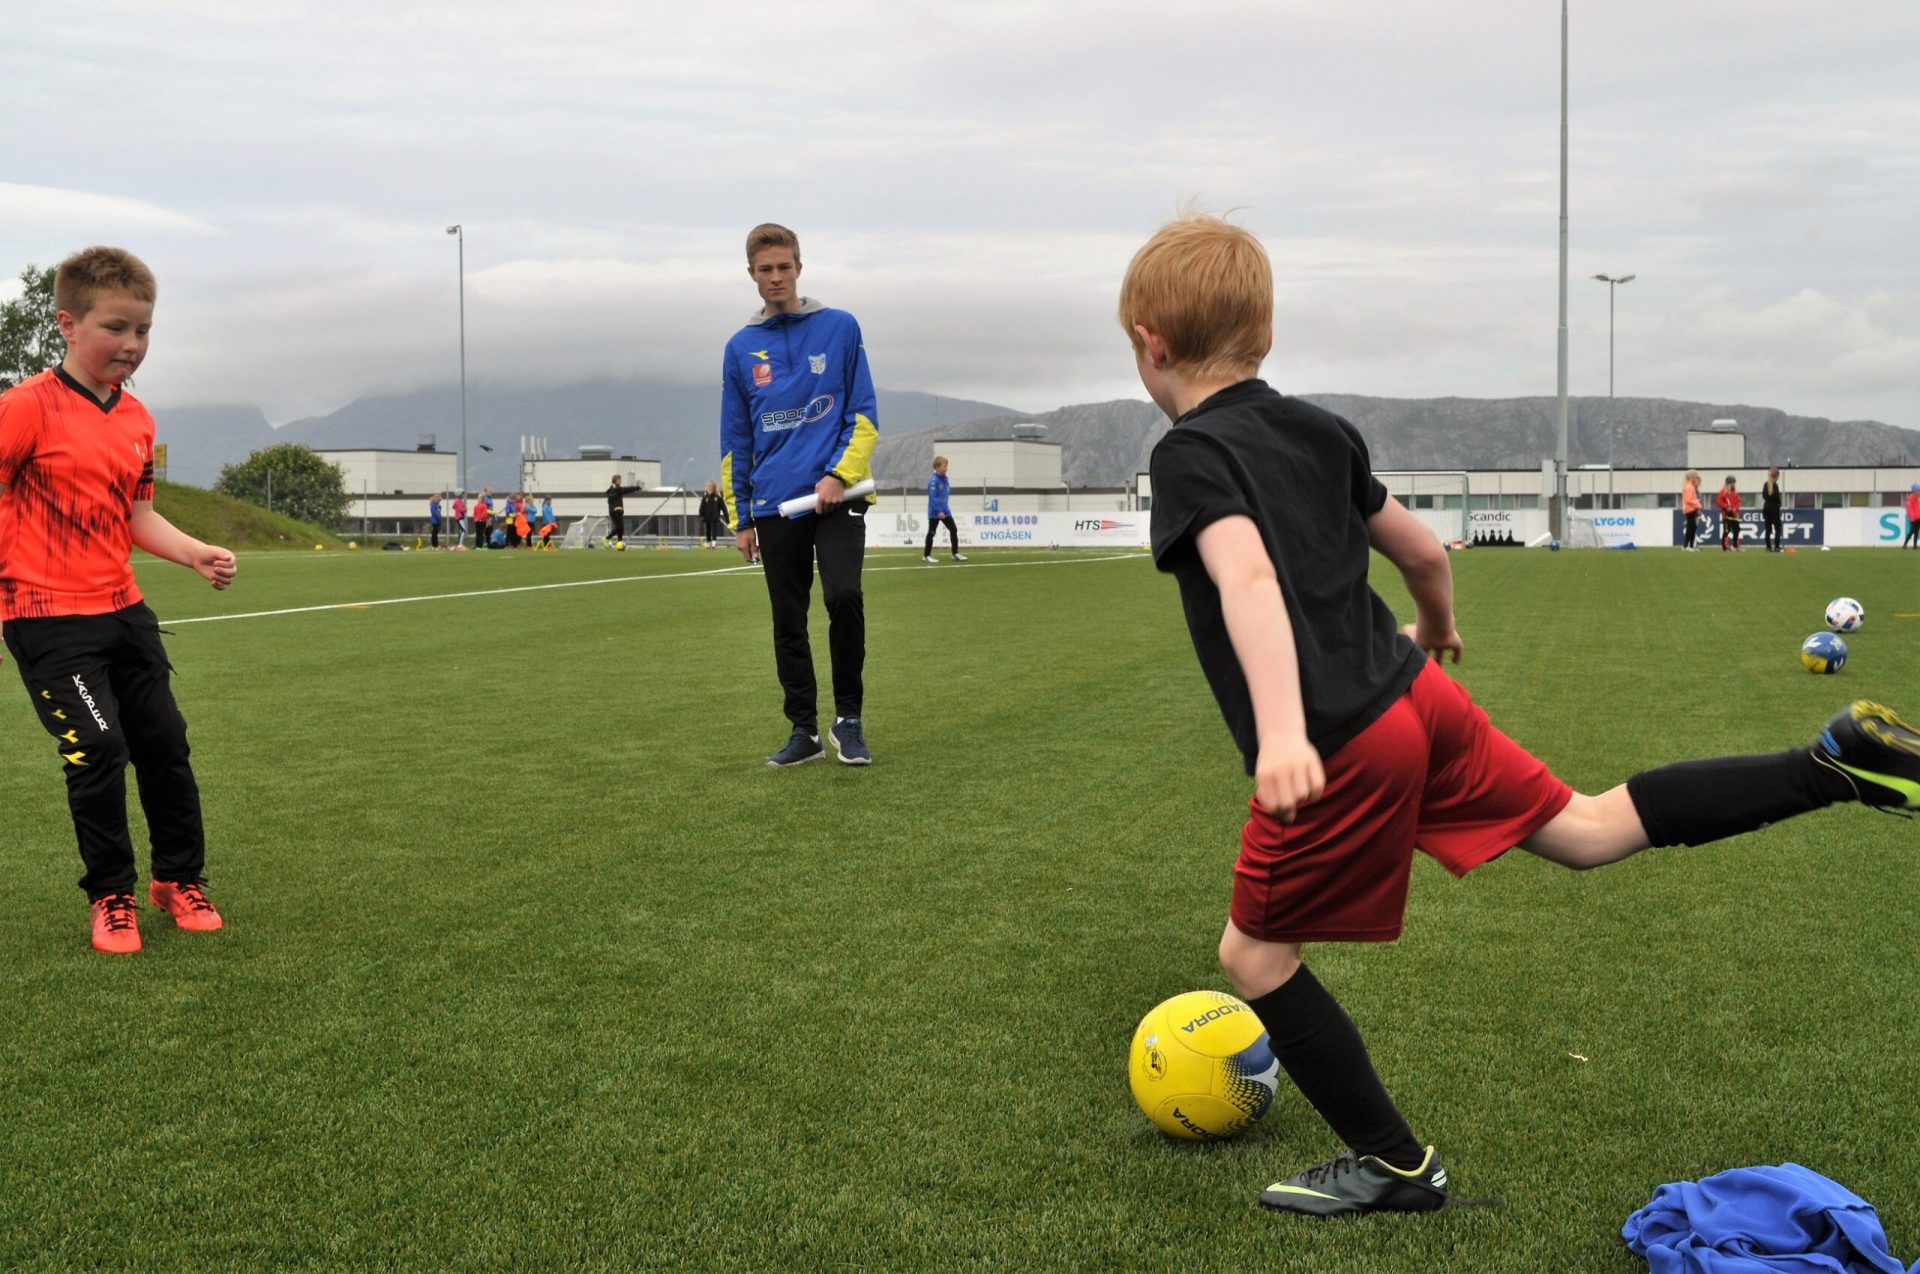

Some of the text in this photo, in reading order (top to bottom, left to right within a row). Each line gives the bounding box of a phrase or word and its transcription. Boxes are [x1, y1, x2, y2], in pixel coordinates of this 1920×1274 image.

[974, 515, 1038, 525] REMA 1000
[1467, 511, 1512, 522] Scandic
[1591, 517, 1635, 526] LYGON
[896, 514, 920, 532] hb
[1074, 520, 1101, 531] HTS
[981, 529, 1032, 540] LYNGÅSEN
[72, 674, 109, 732] KASPER
